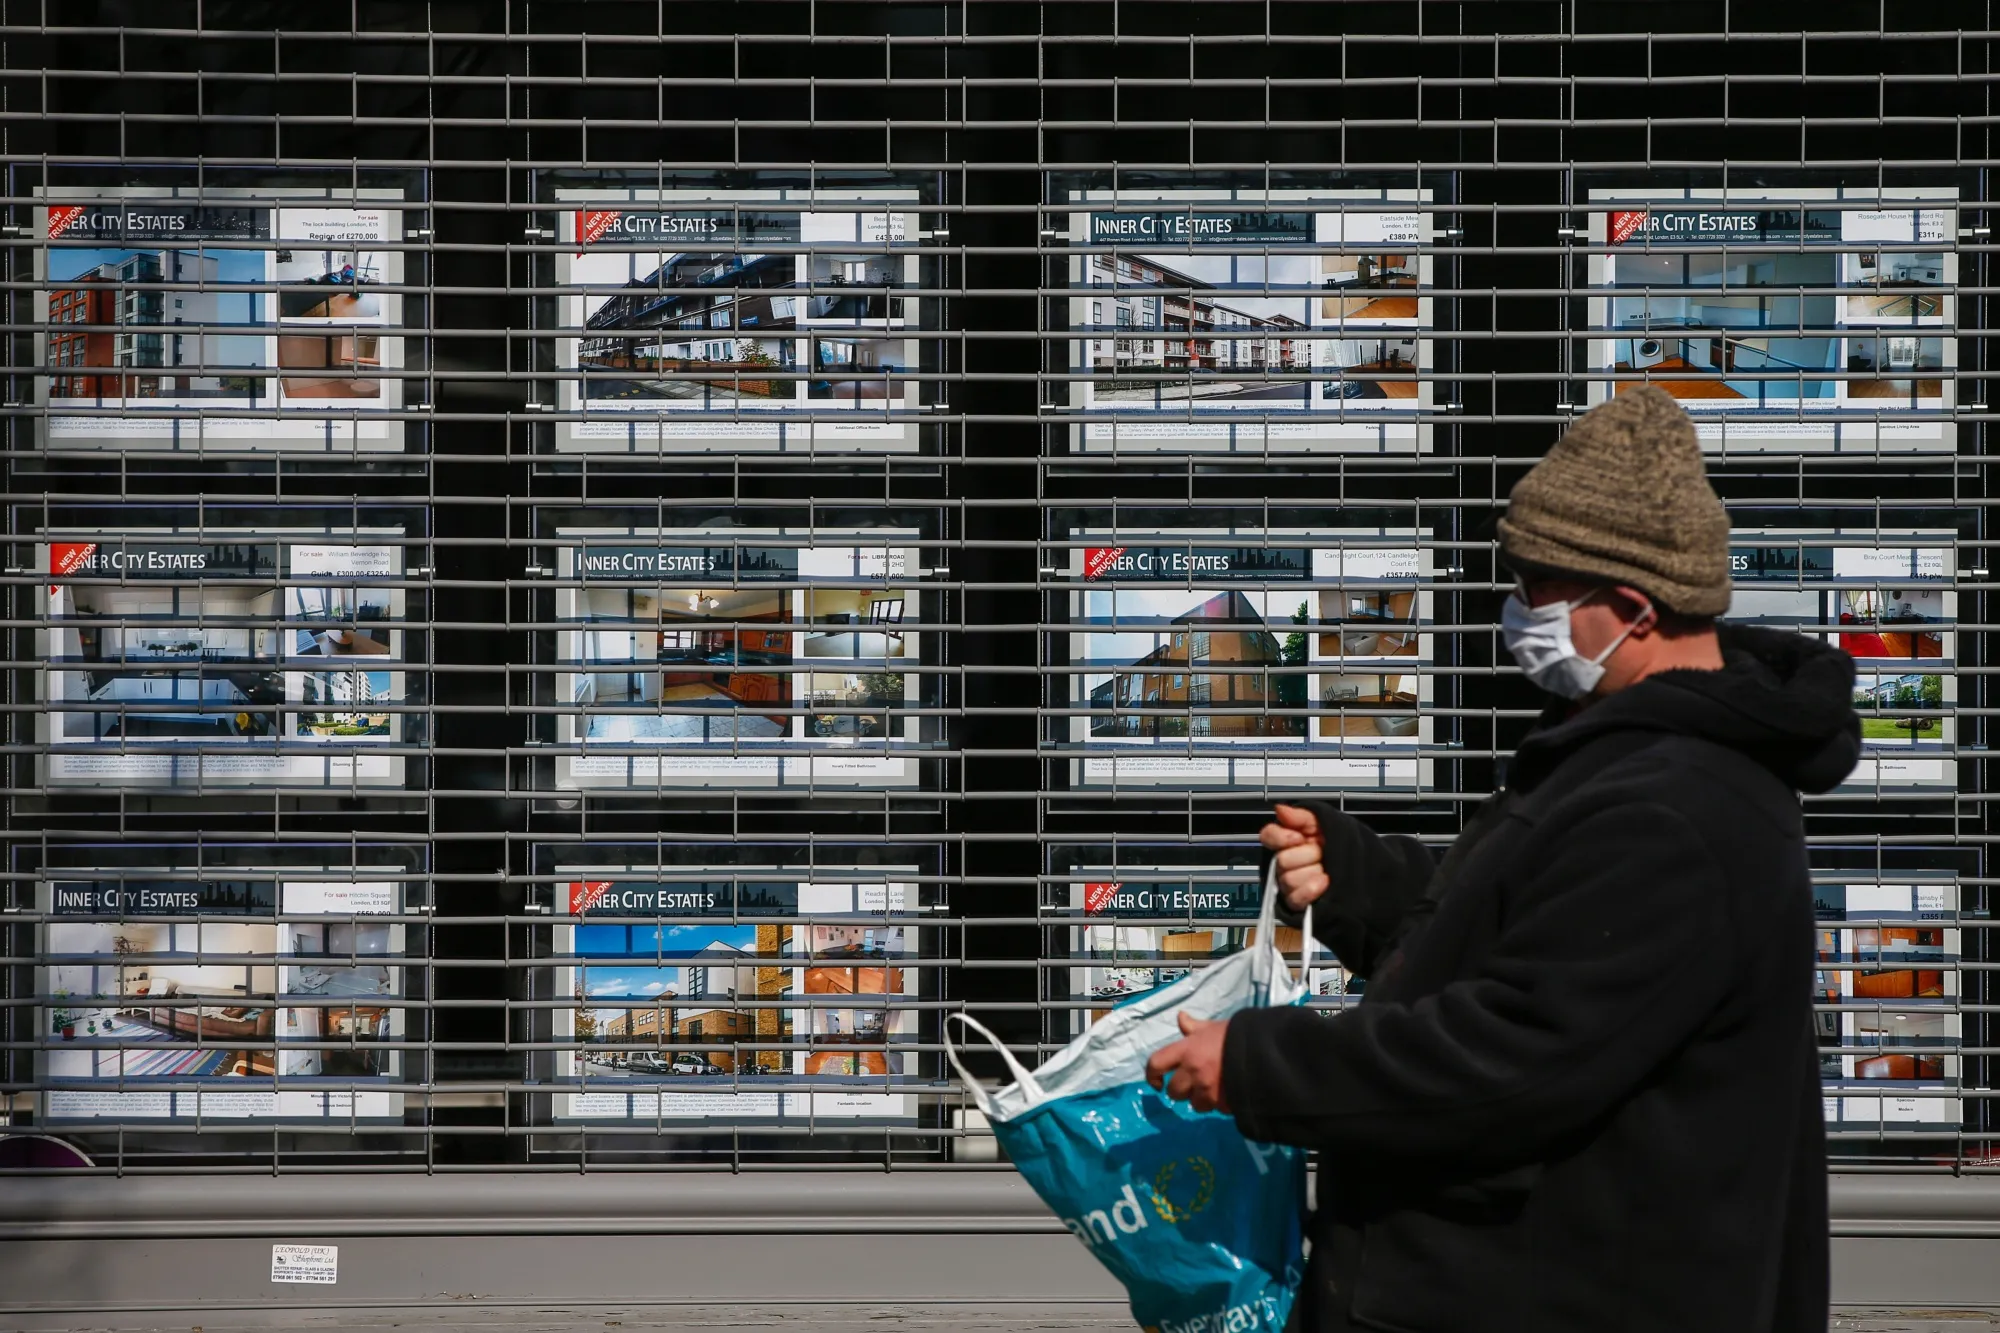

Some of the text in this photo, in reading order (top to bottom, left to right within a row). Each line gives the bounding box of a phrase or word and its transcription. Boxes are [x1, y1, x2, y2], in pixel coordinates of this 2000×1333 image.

[48, 210, 62, 230] NEW
[48, 206, 82, 240] TRUCTION
[91, 213, 121, 230] CITY
[127, 213, 185, 230] ESTATES
[585, 211, 603, 231] NEW
[585, 211, 620, 246] STRUCTIO
[625, 215, 657, 232] CITY
[660, 215, 717, 233] ESTATES
[1095, 216, 1232, 234] INNER CITY ESTATES
[1614, 212, 1631, 231] NEW
[1663, 214, 1695, 231] CITY
[1699, 214, 1756, 231] ESTATES
[309, 233, 335, 241] Region
[346, 233, 378, 241] £270,000
[59, 549, 77, 568] NEW
[81, 554, 108, 569] NER
[148, 552, 205, 569] ESTATES
[622, 553, 654, 571] CITY
[658, 553, 715, 571] ESTATES
[1088, 548, 1106, 568] NEW
[1137, 553, 1169, 571] CITY
[1172, 553, 1229, 571] ESTATES
[58, 889, 100, 907] INNER
[140, 889, 198, 907] ESTATES
[592, 891, 714, 909] NER CITY ESTATES
[1088, 885, 1104, 906] NEW
[1138, 891, 1170, 909] CITY
[1173, 891, 1230, 909] ESTATES
